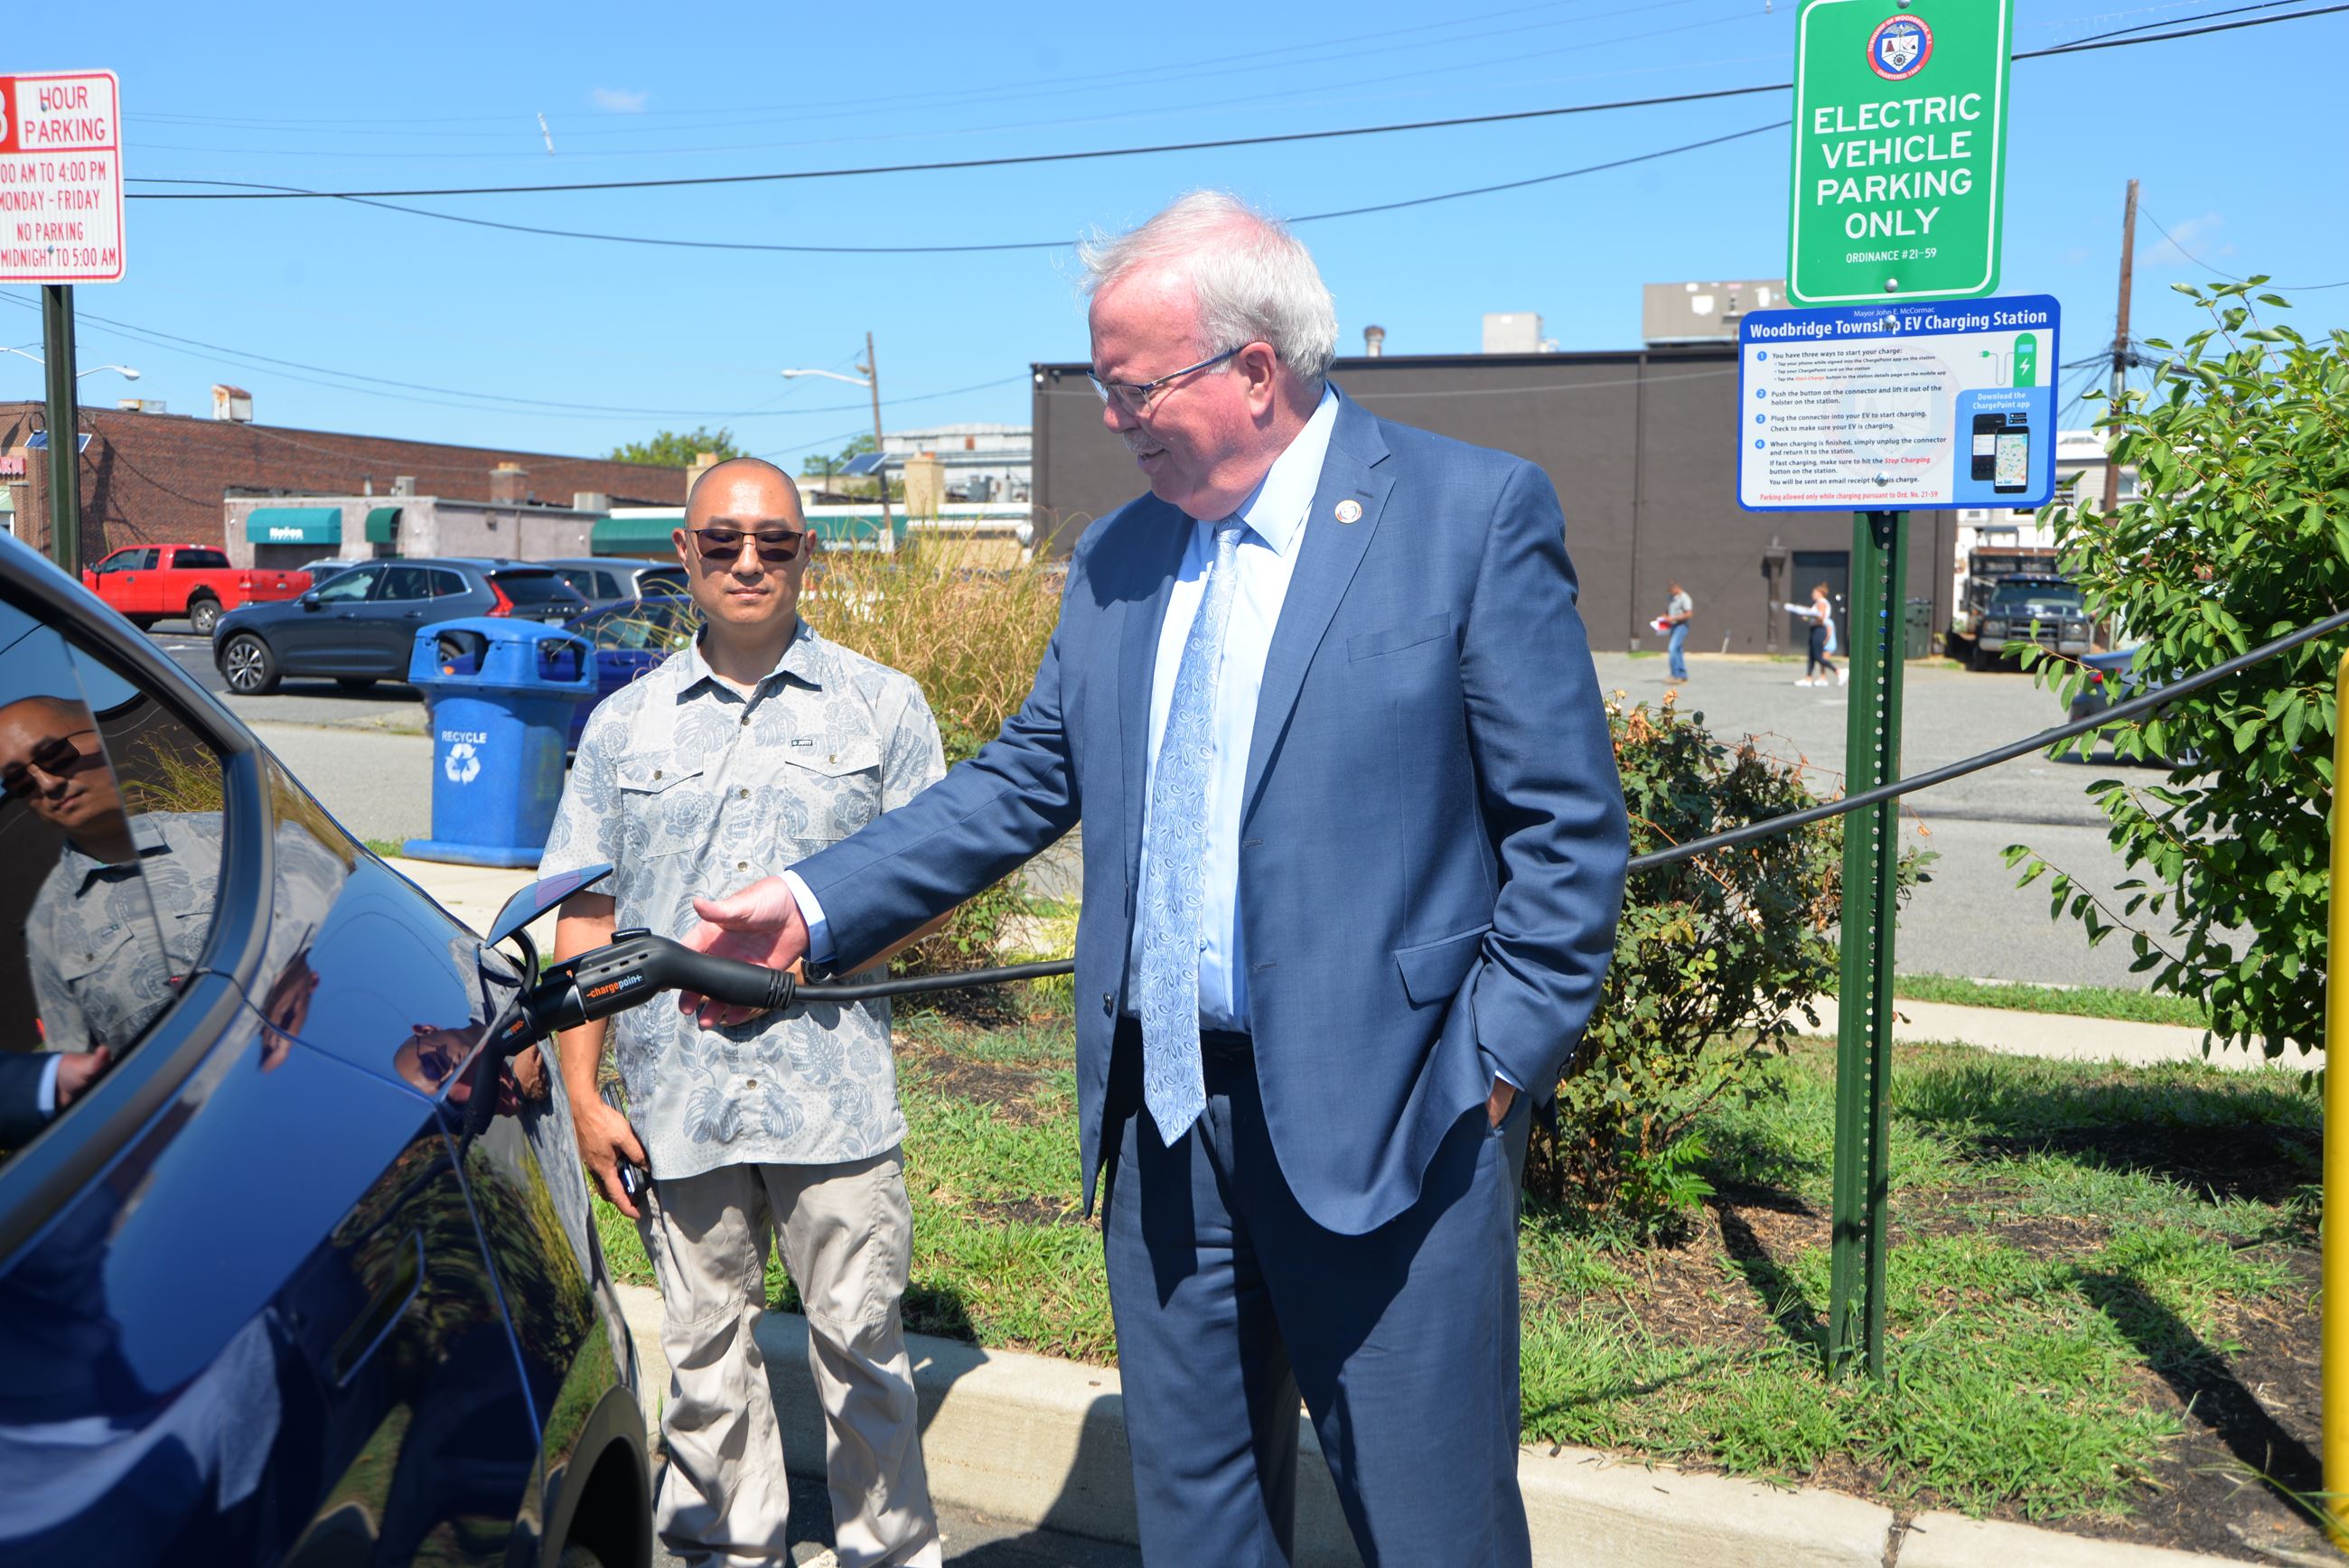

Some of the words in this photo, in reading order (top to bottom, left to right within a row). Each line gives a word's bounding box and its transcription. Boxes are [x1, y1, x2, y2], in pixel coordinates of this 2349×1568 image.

[39, 86, 88, 110] HOUR
[1814, 93, 1981, 135] ELECTRIC
[24, 117, 106, 143] PARKING
[1821, 131, 1972, 169] VEHICLE
[0, 163, 15, 183] 00
[21, 163, 36, 183] AM
[40, 163, 54, 182] TO
[59, 162, 86, 182] 4:00
[89, 161, 107, 181] PM
[1817, 168, 1972, 206] PARKING
[58, 190, 99, 210] FRIDAY
[17, 223, 32, 241] NO
[35, 222, 84, 241] PARKING
[1845, 207, 1941, 239] ONLY
[56, 247, 69, 266] TO
[73, 247, 97, 266] 5:00
[101, 247, 116, 266] AM
[1846, 250, 1900, 264] ORDINANCE
[1902, 247, 1937, 259] #21-59
[1853, 310, 1876, 318] Mayor
[1899, 307, 1934, 315] McCormac
[1750, 321, 1832, 339] Woodbridge
[1835, 318, 1901, 335] Townshp
[1904, 316, 1922, 331] EV
[1924, 313, 1989, 331] Charging
[1993, 309, 2047, 325] Station
[1972, 401, 2016, 410] ChargePoint
[1977, 392, 2013, 400] Download
[1770, 415, 1785, 423] Plug
[1854, 438, 1876, 446] simply
[1759, 493, 1782, 501] Parking
[1836, 492, 1861, 500] charging
[1896, 490, 1908, 499] Ord.
[442, 730, 487, 744] RECYCLE
